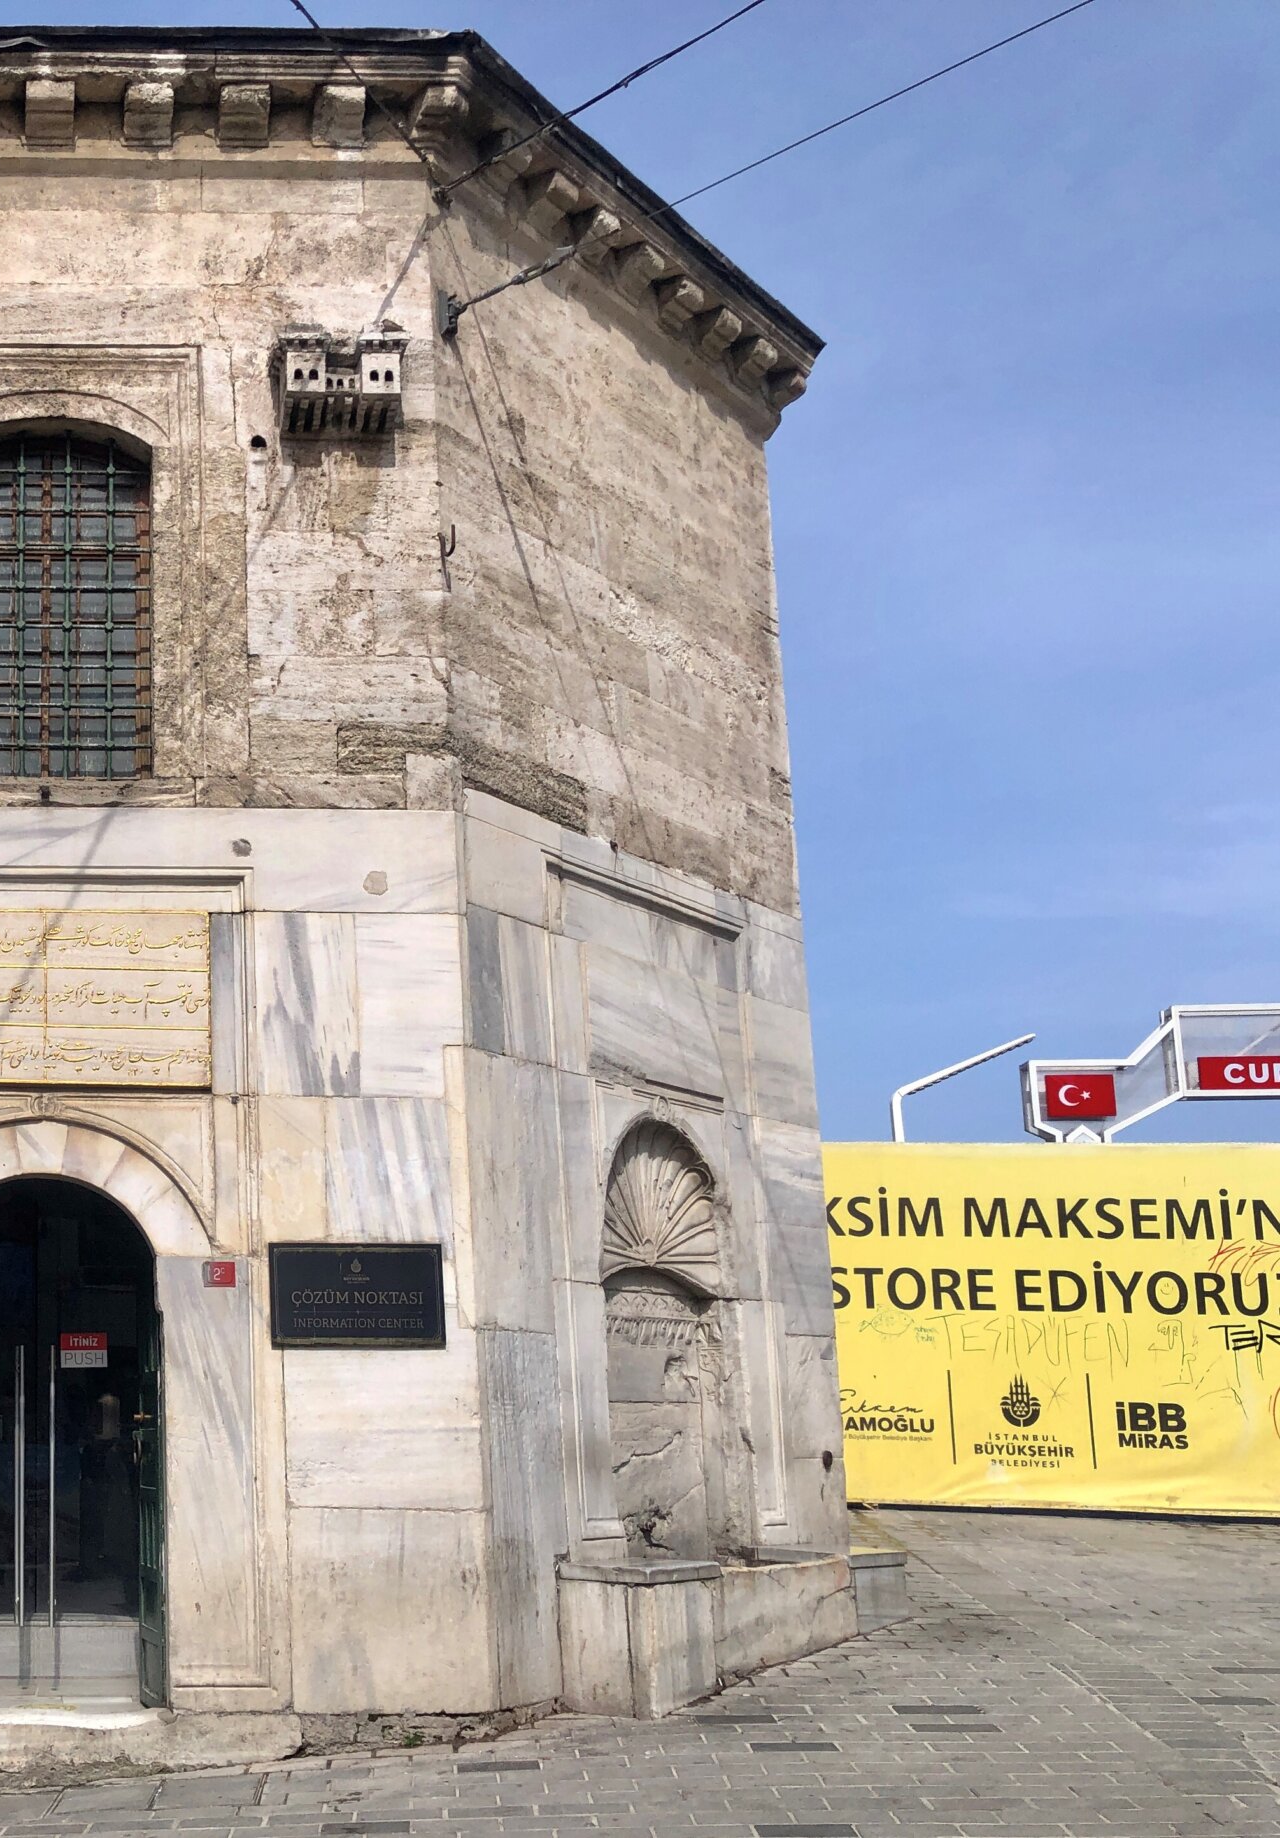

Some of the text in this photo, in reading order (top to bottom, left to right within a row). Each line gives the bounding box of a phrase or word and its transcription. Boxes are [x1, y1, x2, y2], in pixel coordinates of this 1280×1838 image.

[831, 1267, 996, 1311] STORE
[1014, 1260, 1280, 1316] EDİYORU
[291, 1289, 424, 1307] ÇÖZÜM NOKTASI
[293, 1318, 424, 1329] INFORMATION CENTER
[64, 1352, 104, 1366] PUSH
[841, 1415, 935, 1433] AMOĞLU
[988, 1431, 1058, 1442] İSTANBUL
[973, 1442, 1075, 1458] BÜYÜKŞEHİR
